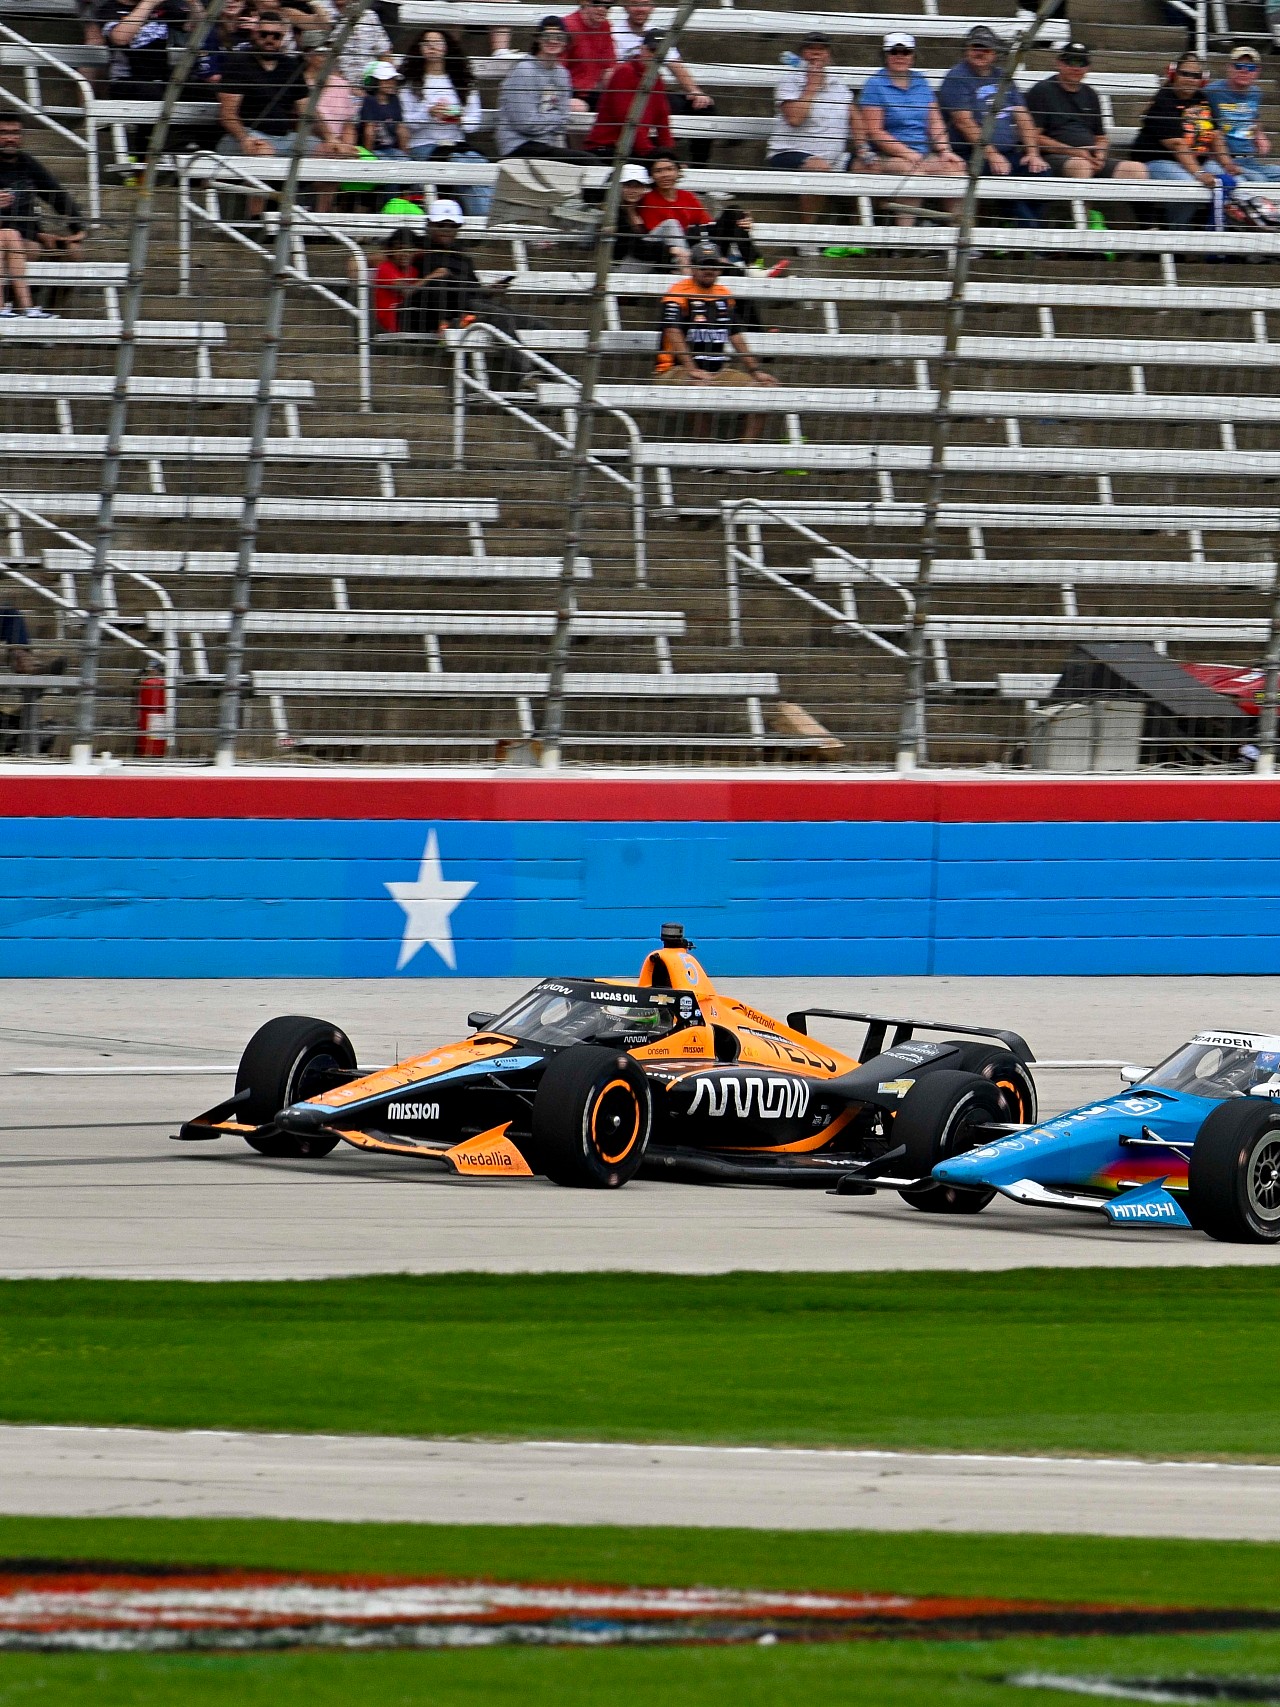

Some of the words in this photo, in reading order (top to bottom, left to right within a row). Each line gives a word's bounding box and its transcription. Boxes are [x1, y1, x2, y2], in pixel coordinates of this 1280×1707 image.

[678, 952, 698, 985] 5
[590, 991, 622, 1002] LUCAS
[623, 993, 638, 1003] OIL
[747, 1009, 776, 1031] Electrolit
[686, 1077, 810, 1119] ARROW
[456, 1150, 512, 1166] Medallia
[1111, 1202, 1176, 1218] HITACHI
